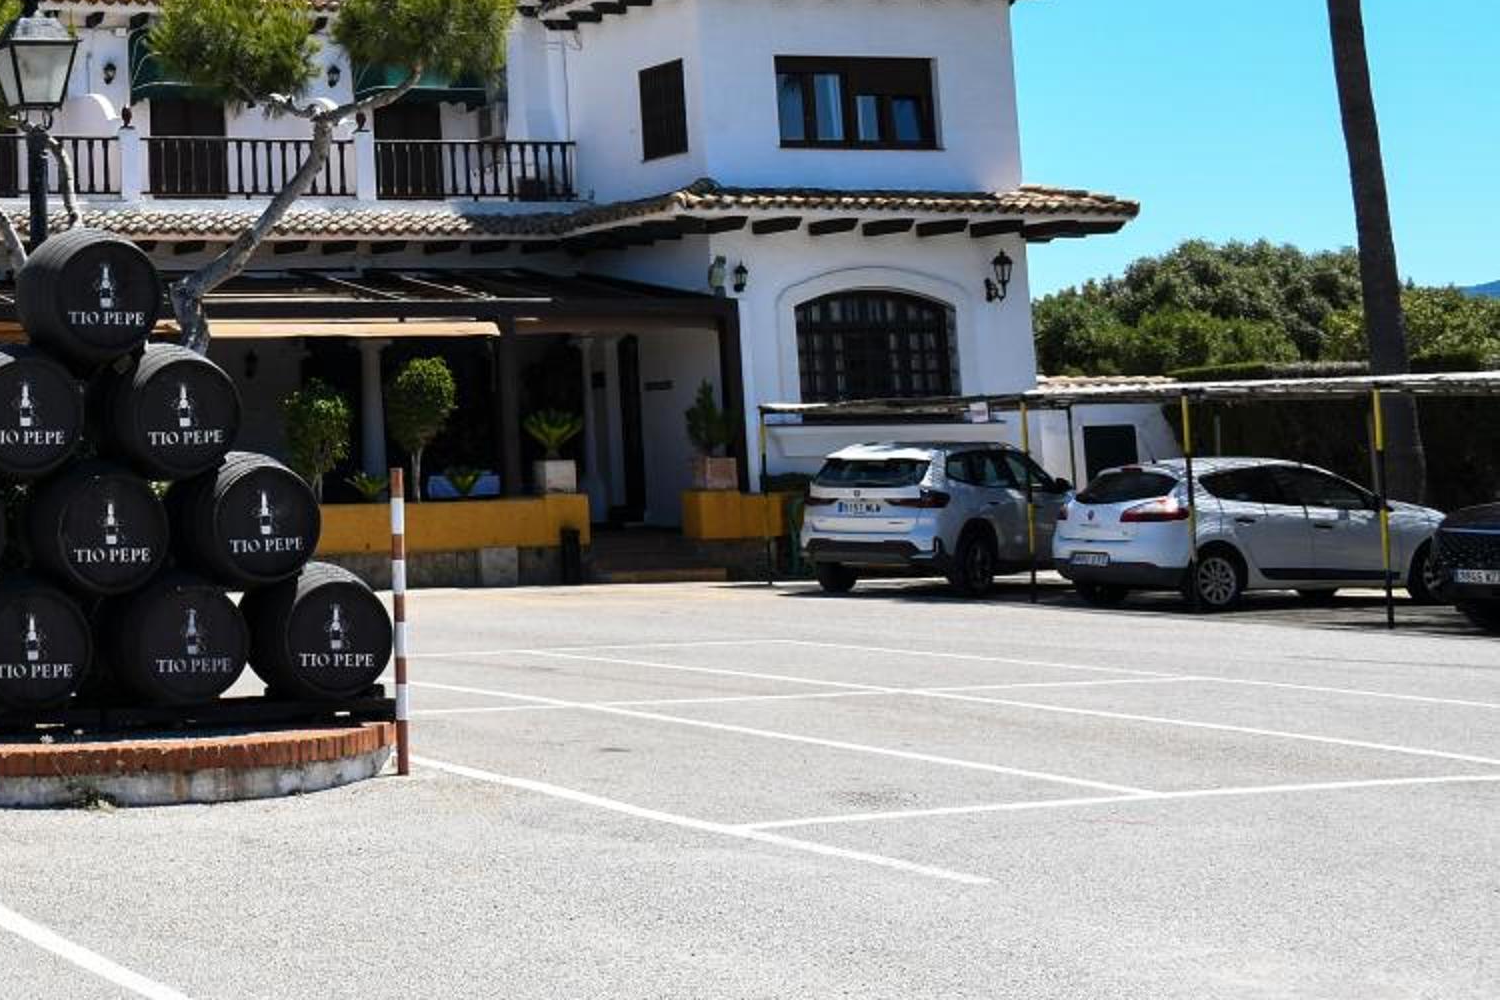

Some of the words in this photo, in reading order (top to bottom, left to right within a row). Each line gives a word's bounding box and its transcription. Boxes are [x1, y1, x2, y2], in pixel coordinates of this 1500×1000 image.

[68, 311, 99, 325] TIO
[104, 311, 145, 326] PEPE
[24, 430, 65, 445] PEPE
[148, 431, 179, 445] TIO
[184, 430, 224, 444] PEPE
[230, 539, 261, 553] TIO
[265, 537, 304, 552] PEPE
[73, 548, 105, 563] TIO
[109, 548, 151, 563] PEPE
[156, 658, 187, 673] TIO
[192, 657, 233, 673] PEPE
[300, 653, 331, 667] TIO
[335, 653, 376, 667] PEPE
[32, 663, 73, 679] PEPE
